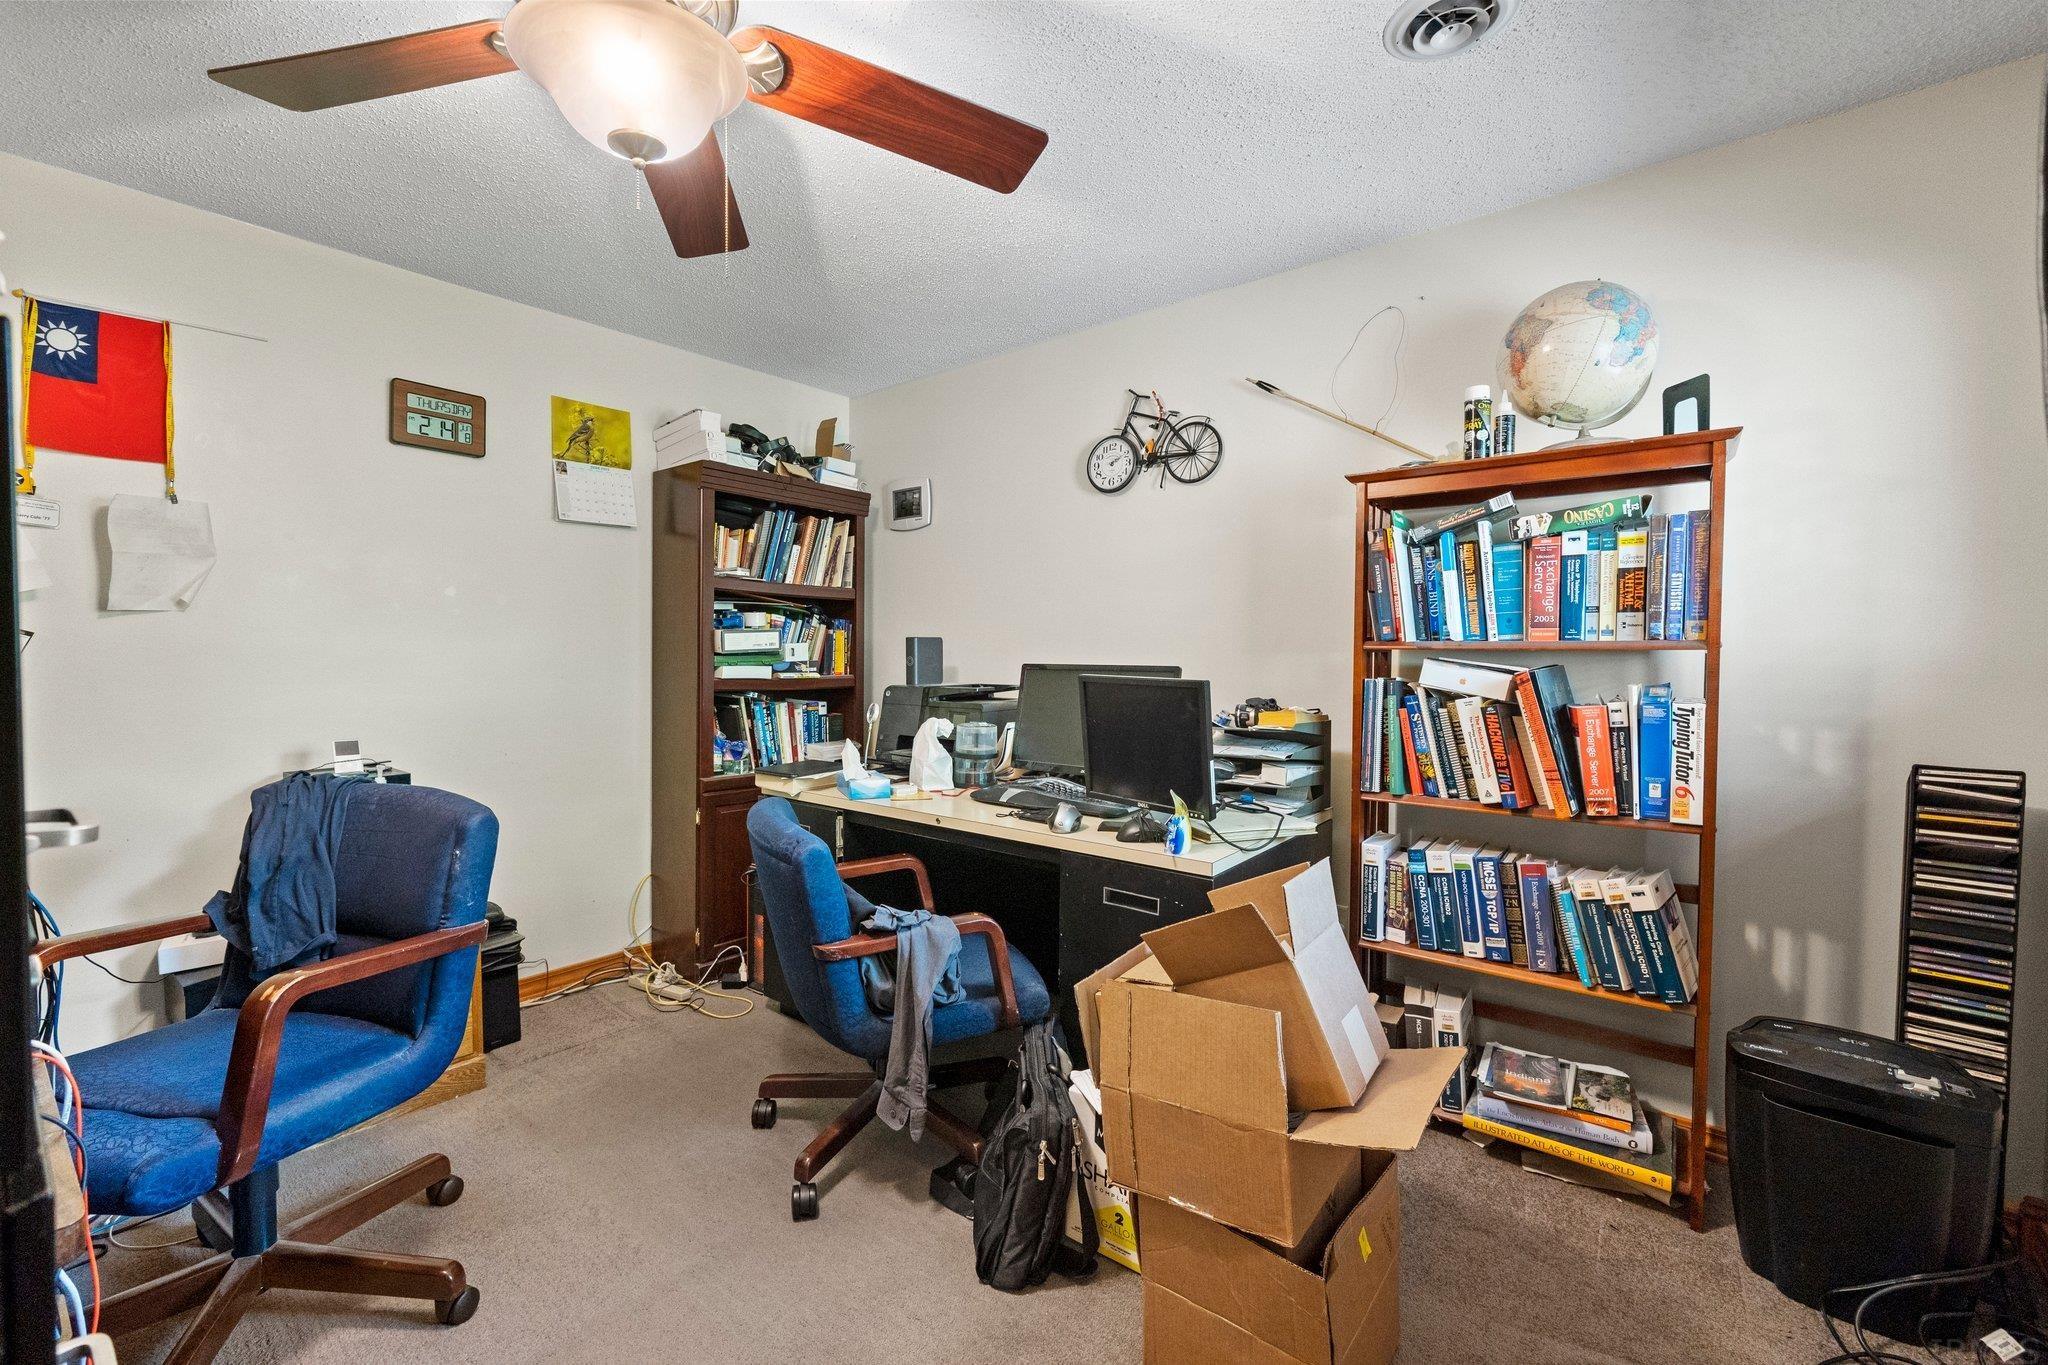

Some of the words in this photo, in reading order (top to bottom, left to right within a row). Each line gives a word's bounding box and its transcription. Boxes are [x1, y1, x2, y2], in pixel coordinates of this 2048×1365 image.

[416, 397, 472, 417] THURSDAY
[460, 424, 472, 432] JUN
[464, 432, 471, 444] 8
[1564, 501, 1614, 524] CASINO
[1411, 547, 1423, 585] HARDENING
[1695, 528, 1704, 581] Mathematical
[1374, 565, 1383, 593] STATISTICS
[1427, 559, 1437, 581] DNS
[1483, 551, 1491, 581] Arithmetic
[1488, 591, 1496, 613] Algebra
[1534, 561, 1545, 594] Server
[1634, 570, 1645, 597] HTML
[1466, 576, 1477, 601] TELECOM
[1545, 560, 1558, 613] Exchange
[1625, 572, 1636, 607] XHTML
[1672, 573, 1684, 611] STATISTICS
[1428, 591, 1440, 618] BIND
[1469, 602, 1481, 635] DICTIONARY
[1534, 614, 1555, 623] 2003
[1415, 713, 1427, 749] STATISTICS
[1487, 713, 1506, 762] HACKING
[1586, 719, 1597, 757] Exchange
[1672, 707, 1695, 750] Typing
[1440, 737, 1451, 777] FUNDAMENTALS
[1482, 750, 1491, 779] Handbook
[1675, 750, 1695, 786] Tutor
[1499, 769, 1512, 793] TiVo
[1590, 759, 1599, 788] Server
[1590, 788, 1609, 796] 2007
[1675, 786, 1695, 801] 6
[1417, 874, 1427, 898] CCNA
[1482, 861, 1498, 890] MCSE
[1443, 896, 1451, 916] ICND2
[1531, 881, 1540, 909] Exchange
[1420, 898, 1431, 927] 200-301
[1485, 900, 1500, 935] TCP/IP
[1565, 911, 1578, 936] REFERENCE
[1648, 914, 1658, 940] Deploying
[1622, 908, 1642, 956] CCENT/CCNA
[1637, 956, 1650, 979] ICND1
[1653, 949, 1664, 974] Solutions
[1504, 1068, 1551, 1084] Indiana
[1540, 1118, 1558, 1130] Atlas
[1574, 1126, 1602, 1138] Human
[1603, 1131, 1620, 1144] Body
[1472, 1120, 1530, 1144] ILLUSTRATED
[1530, 1137, 1560, 1155] ATLAS
[1561, 1147, 1576, 1159] OF
[1577, 1152, 1598, 1165] THE
[1598, 1158, 1635, 1177] WORLD
[1114, 1212, 1125, 1227] 2
